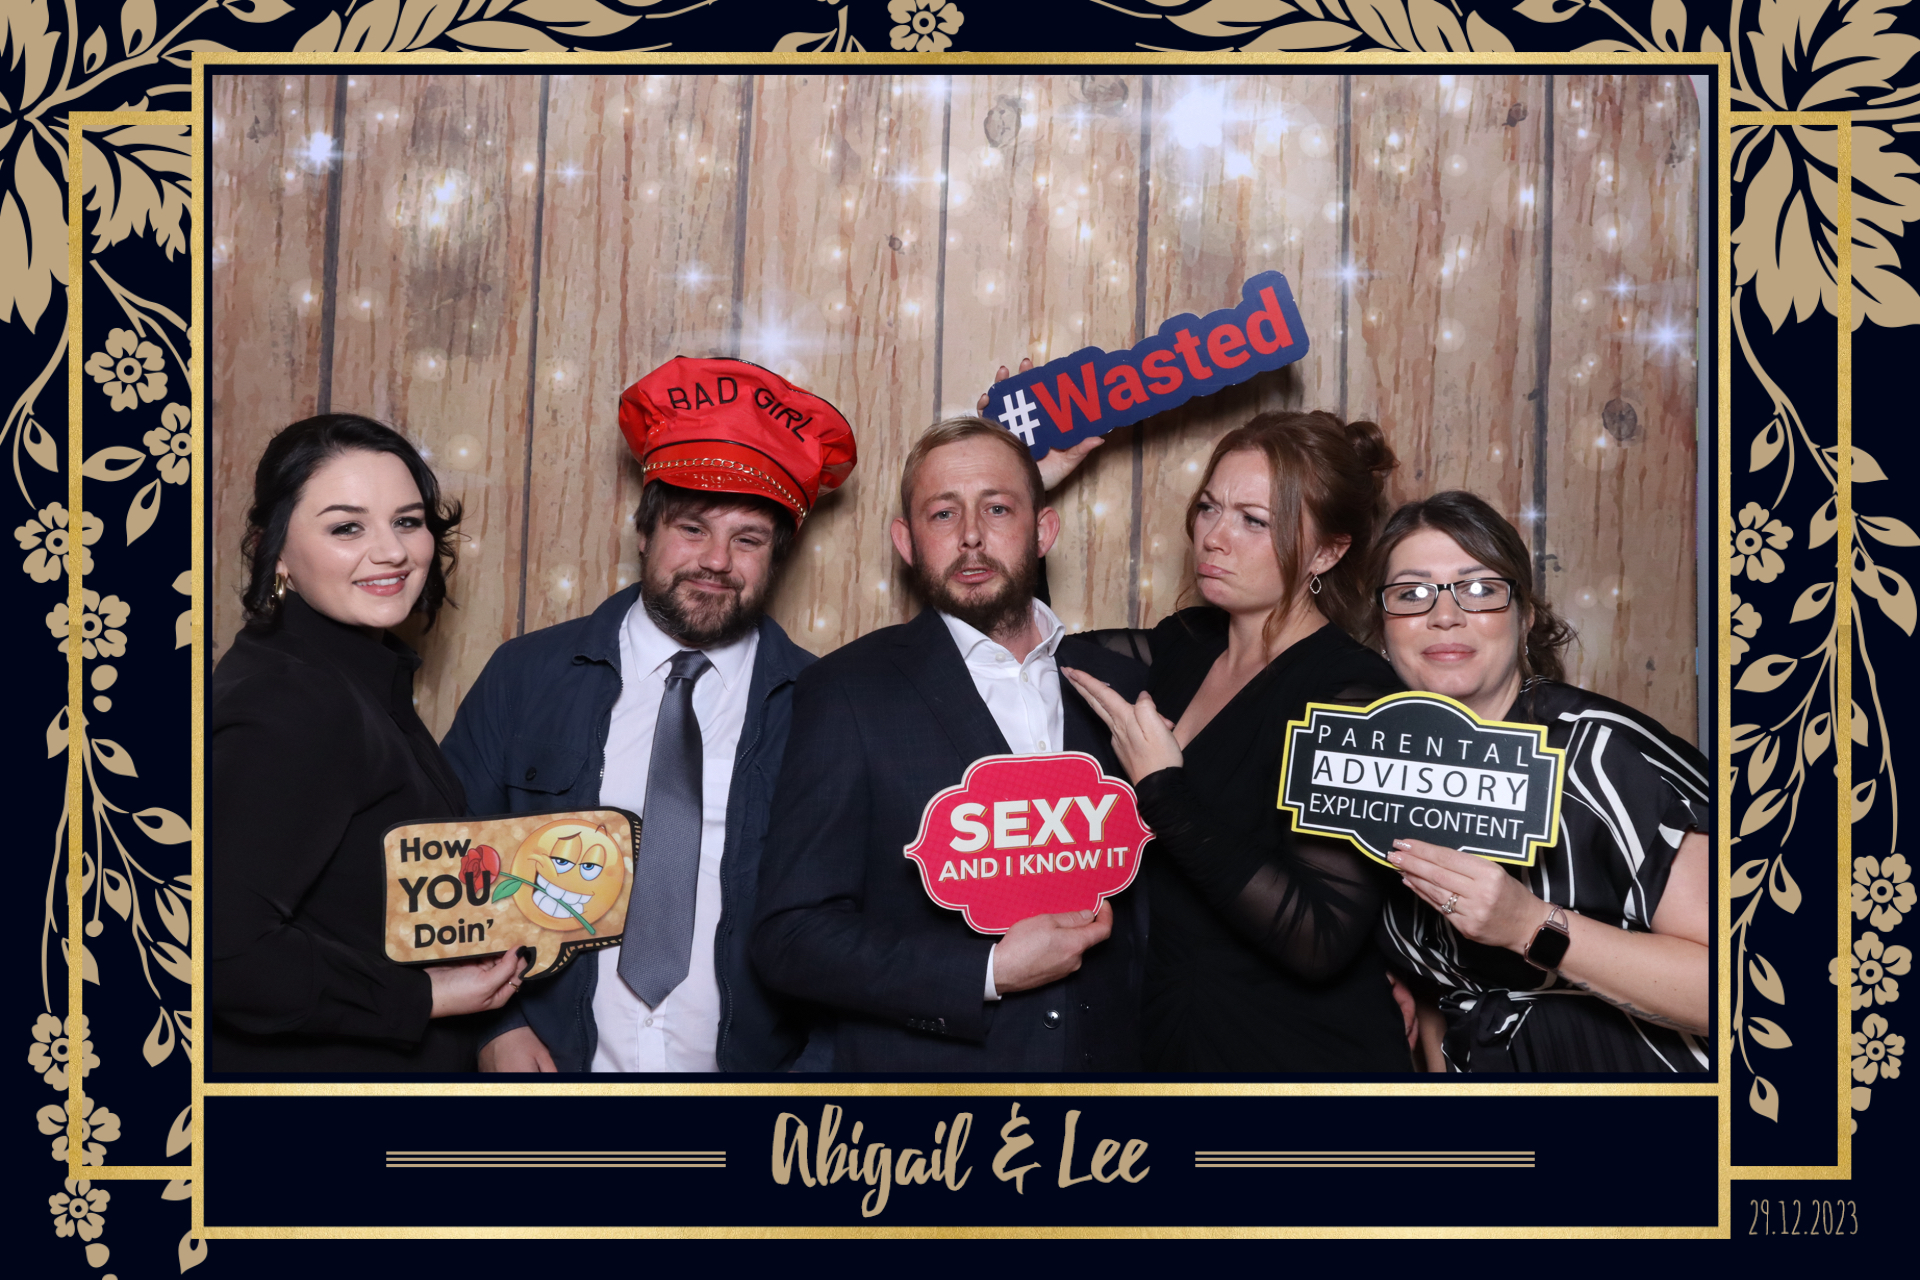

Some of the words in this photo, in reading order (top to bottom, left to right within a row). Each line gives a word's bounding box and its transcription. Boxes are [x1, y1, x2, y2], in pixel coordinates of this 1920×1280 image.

[998, 286, 1294, 447] #Wasted
[667, 377, 738, 410] BAD
[754, 387, 813, 443] GIRL
[1318, 725, 1529, 767] PARENTAL
[1313, 755, 1528, 805] ADVISORY
[949, 794, 1120, 854] SEXY
[1309, 793, 1404, 823] EXPLICIT
[1409, 806, 1524, 840] CONTENT
[400, 837, 471, 862] How
[938, 857, 999, 882] AND
[1005, 855, 1013, 877] I
[1019, 849, 1103, 876] KNOW
[1106, 847, 1130, 868] IT
[398, 870, 492, 913] YOU
